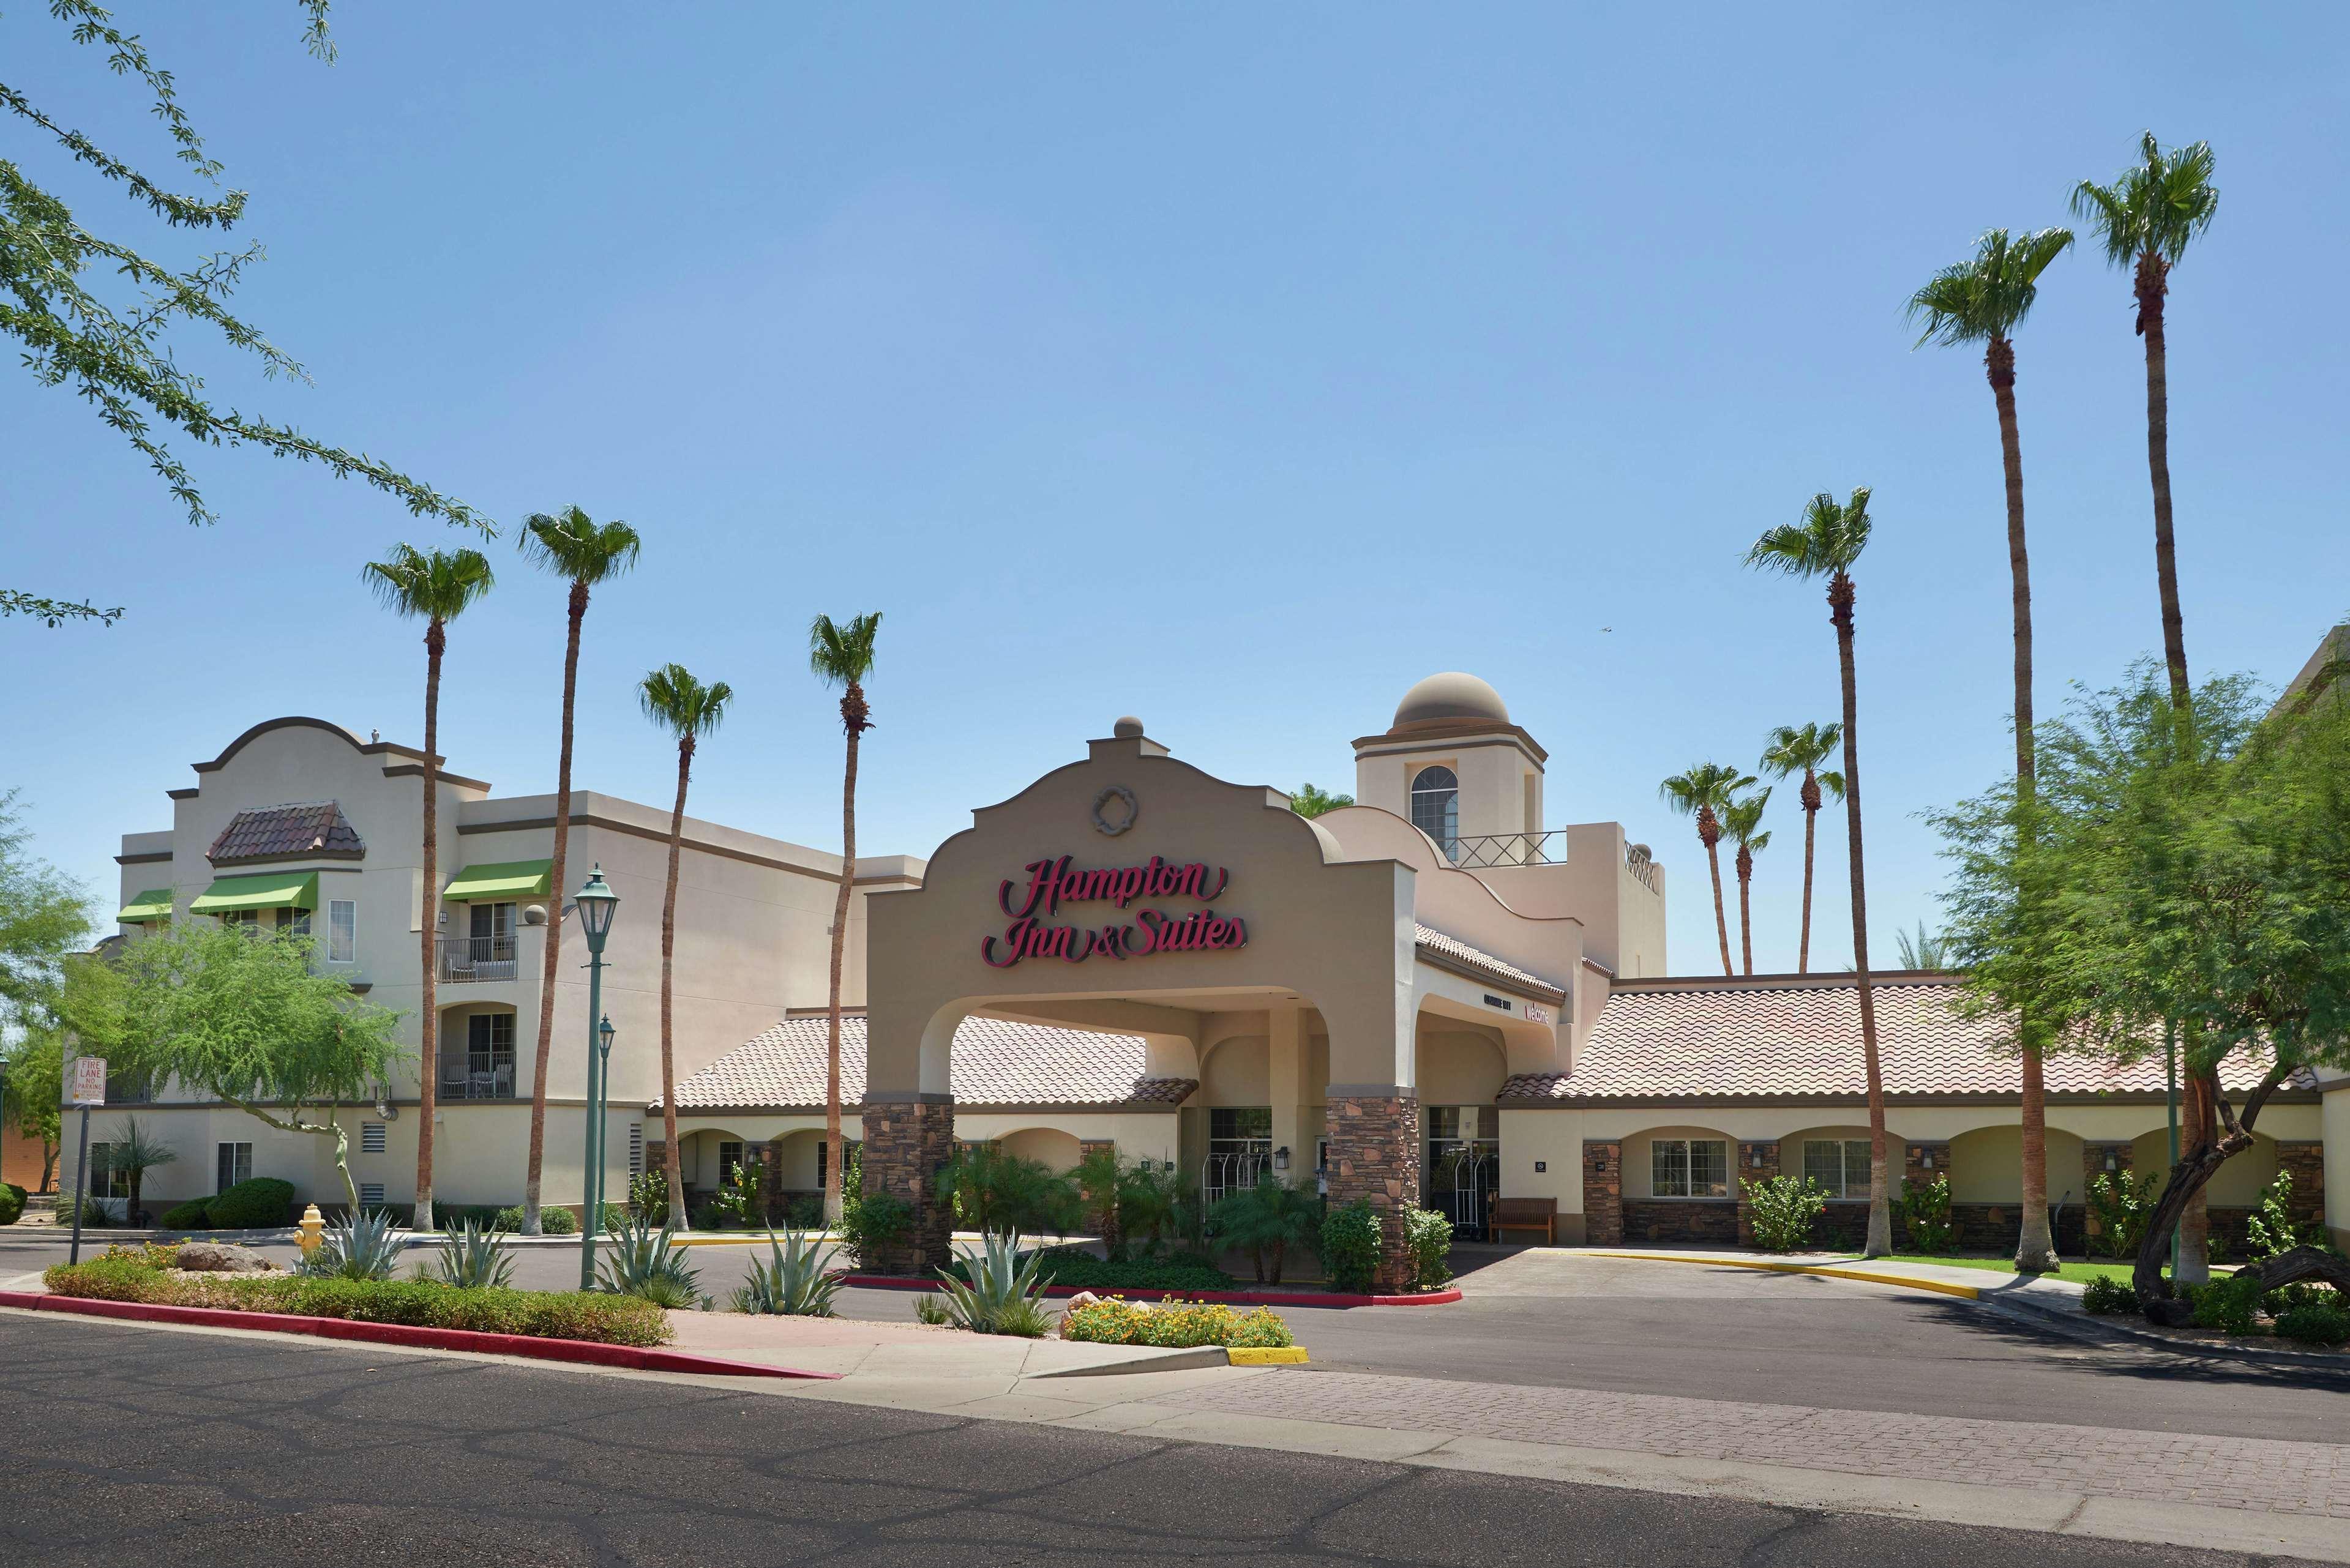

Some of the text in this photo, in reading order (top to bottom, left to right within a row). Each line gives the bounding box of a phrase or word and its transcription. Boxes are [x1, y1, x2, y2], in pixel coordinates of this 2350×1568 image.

[999, 855, 1228, 917] Hampton
[981, 908, 1248, 968] Inn & Suites
[80, 1069, 101, 1078] LANE
[82, 1060, 100, 1070] FIRE
